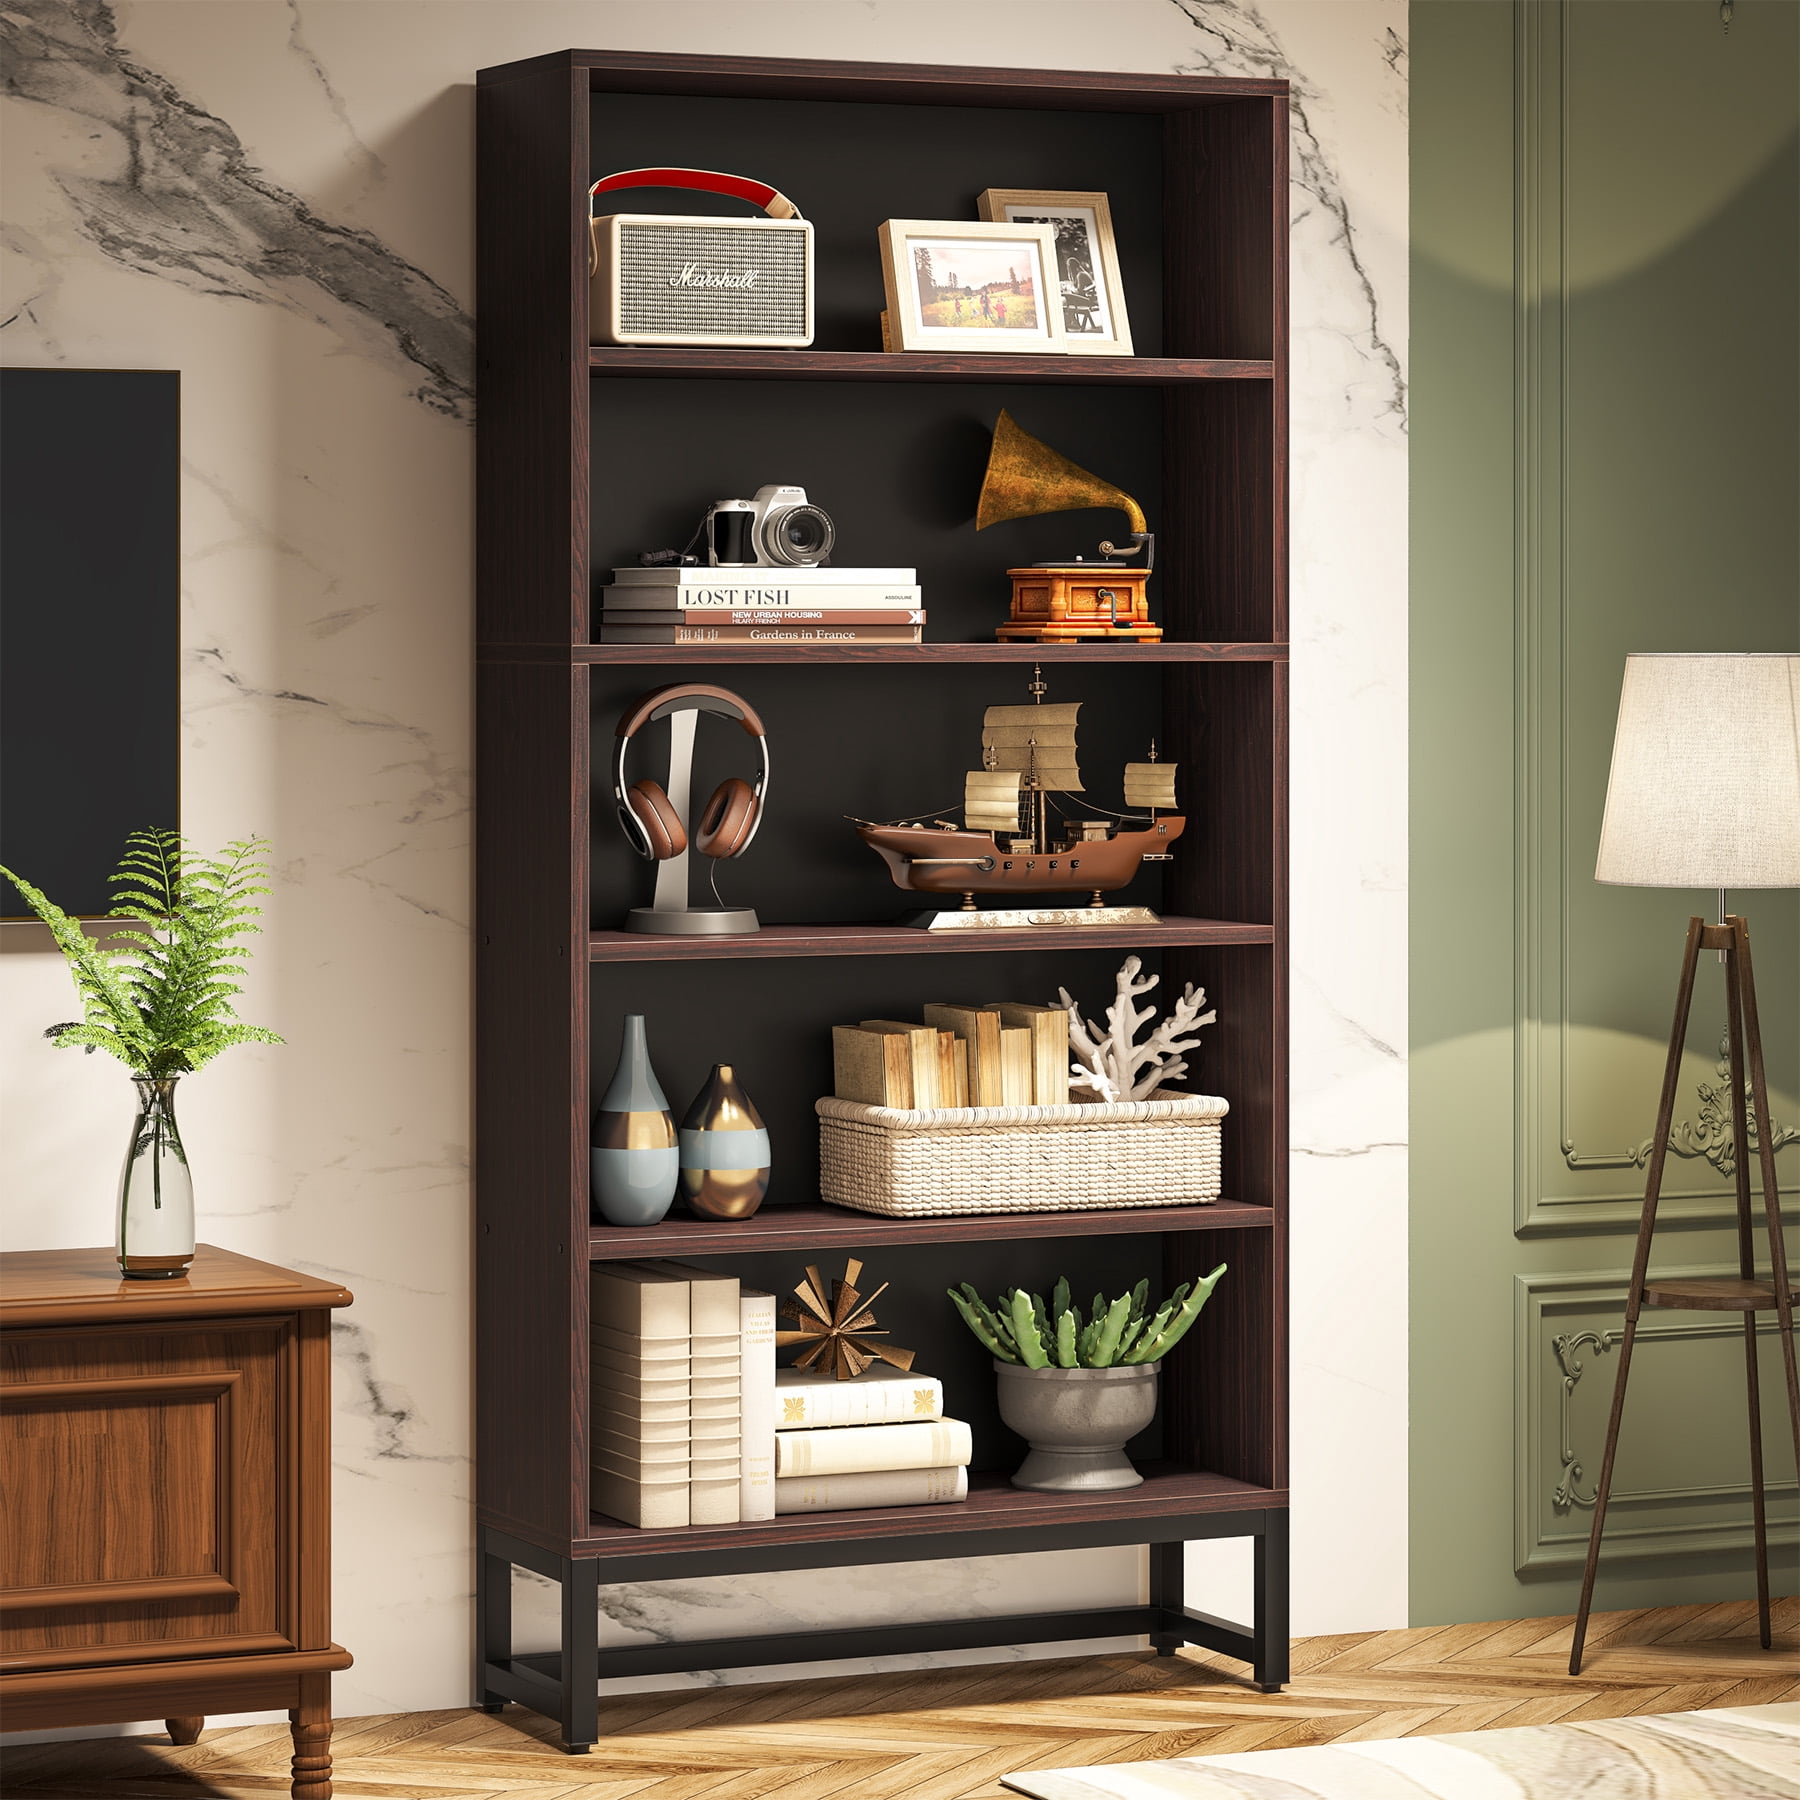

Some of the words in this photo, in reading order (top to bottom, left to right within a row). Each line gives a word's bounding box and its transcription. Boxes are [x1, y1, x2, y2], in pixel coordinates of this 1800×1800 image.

[669, 261, 760, 288] Marshall
[685, 589, 738, 605] LOST
[744, 589, 789, 605] FISH
[750, 629, 799, 640] Gardens
[801, 629, 813, 640] in
[815, 629, 856, 640] France
